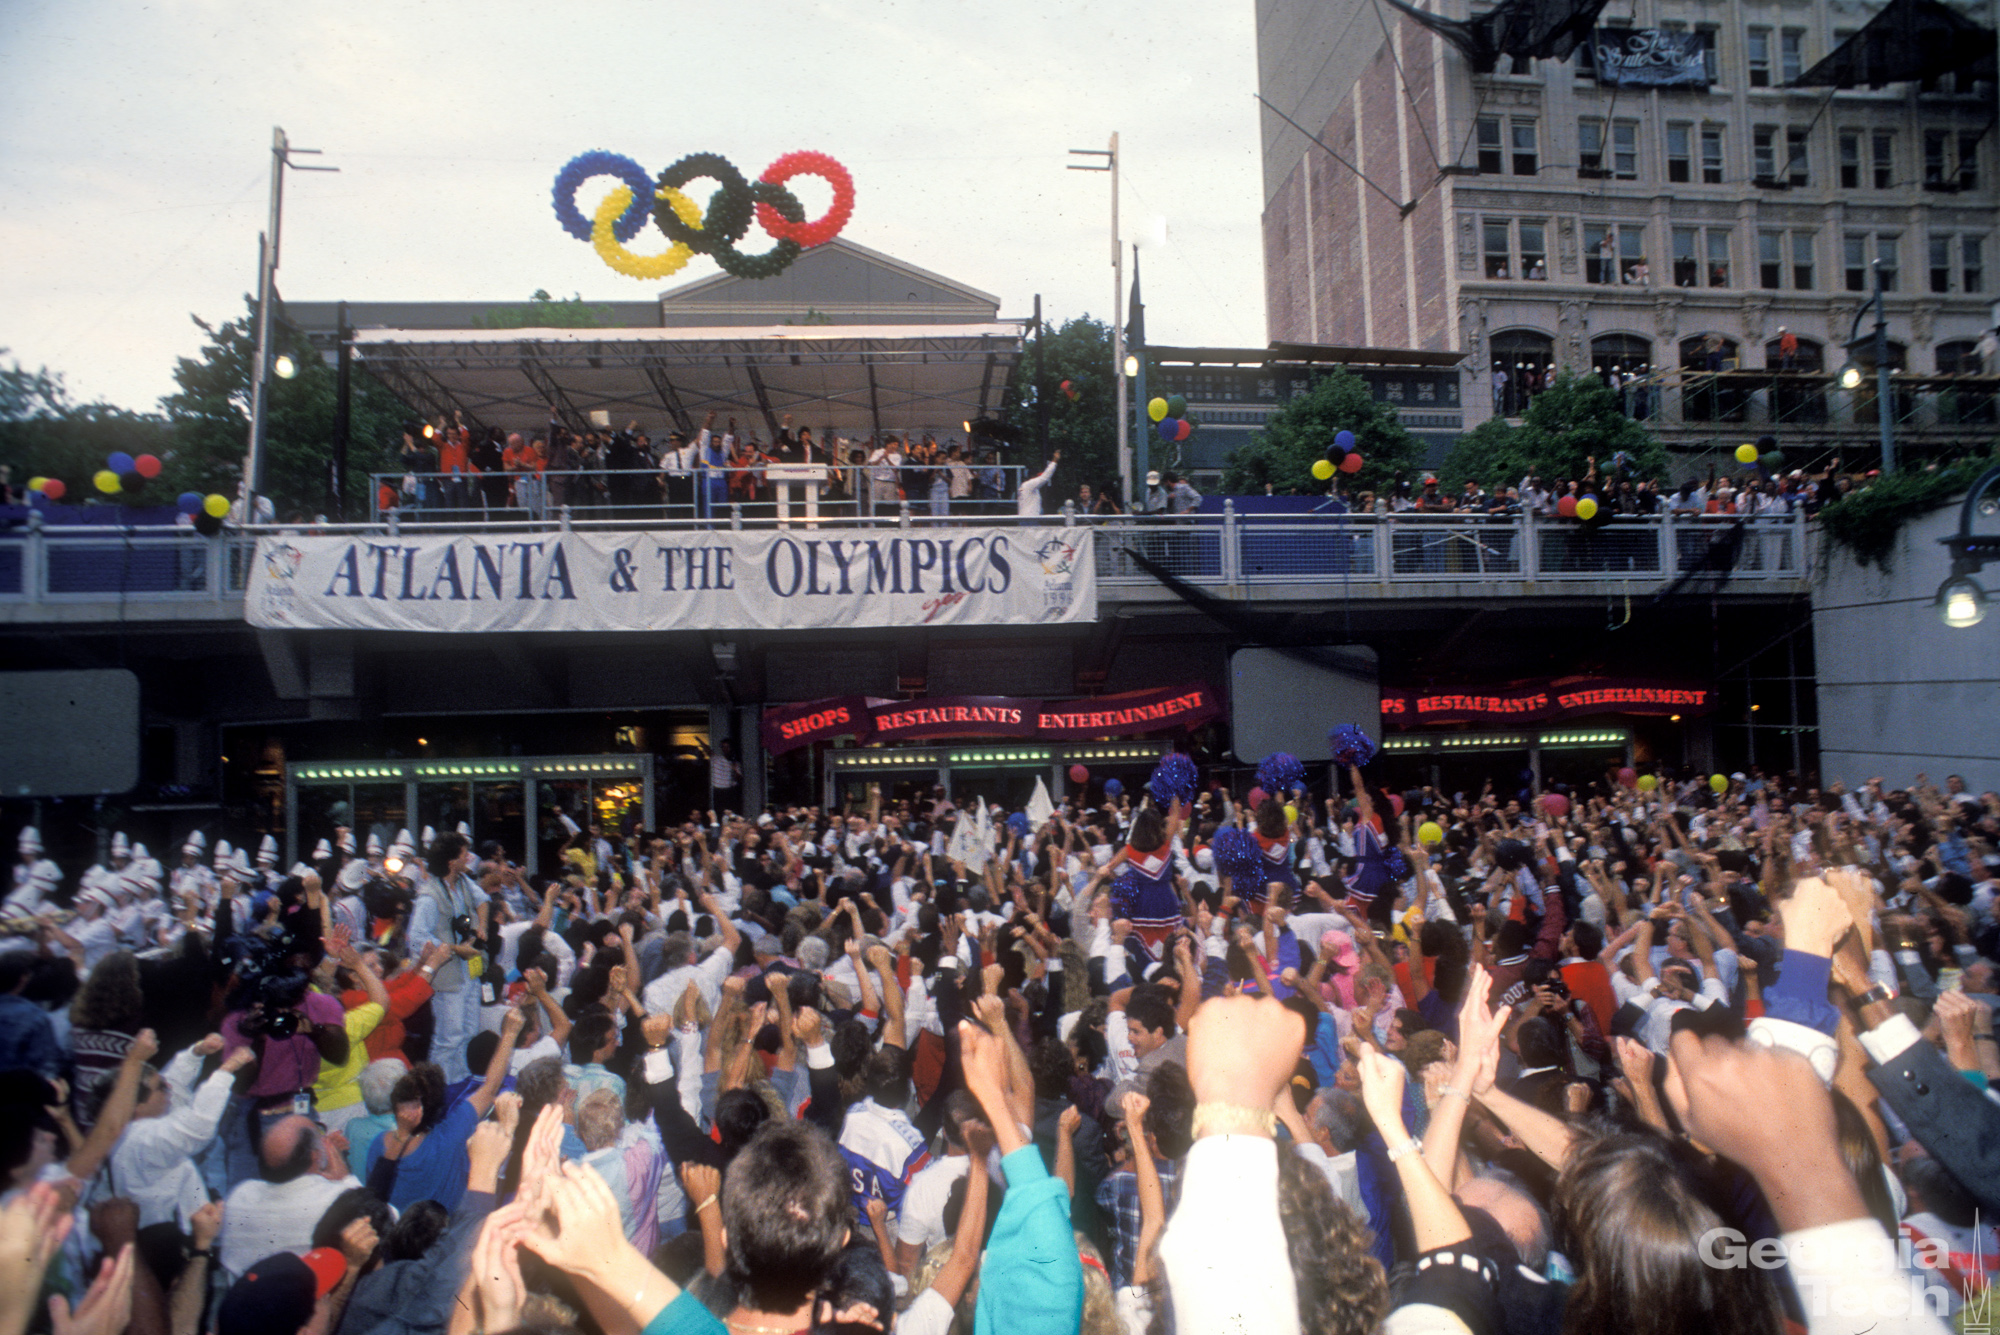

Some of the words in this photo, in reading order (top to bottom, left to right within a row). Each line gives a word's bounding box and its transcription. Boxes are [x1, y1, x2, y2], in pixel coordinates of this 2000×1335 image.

[323, 541, 578, 601] ATLANTA
[609, 547, 639, 593] &
[656, 545, 736, 592] THE
[766, 535, 1013, 598] OLYMPICS
[780, 706, 850, 739] SHOPS
[876, 706, 1021, 731] RESTAURANTS
[1037, 691, 1204, 729] ENTERTAINMENT
[1416, 693, 1548, 713] RESTAURANTS
[1558, 687, 1707, 709] ENTERTAINMENT
